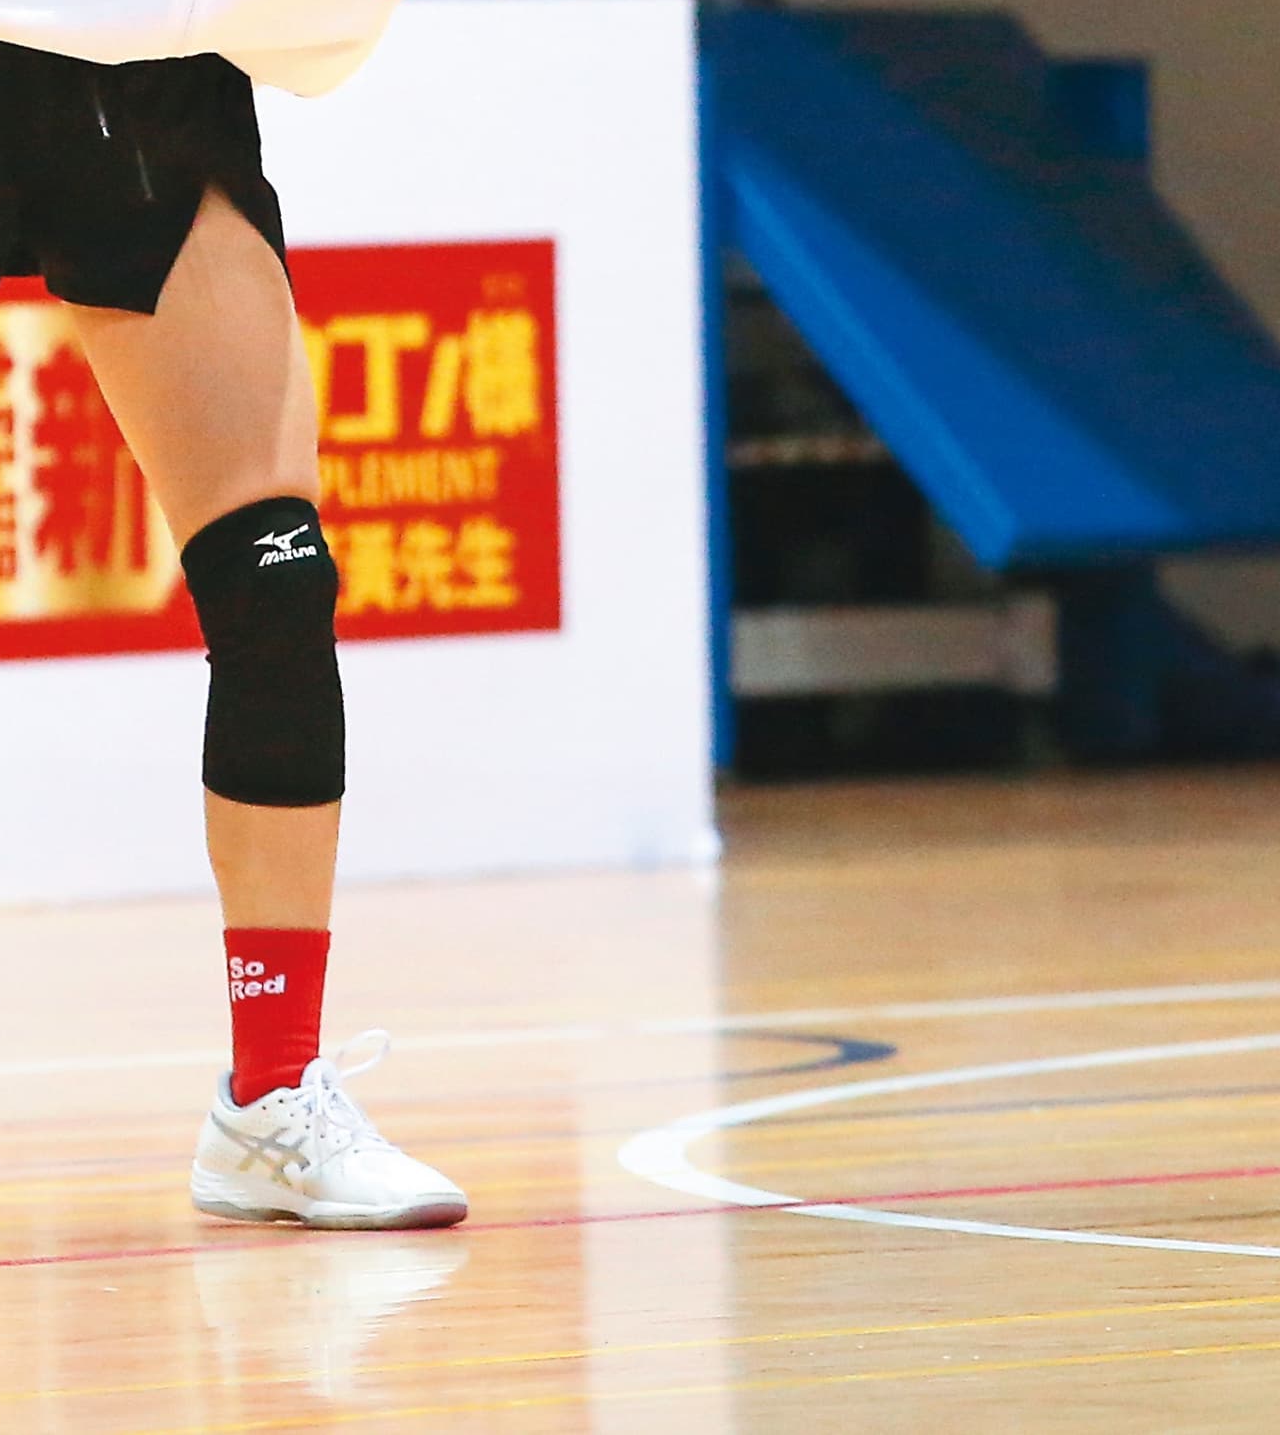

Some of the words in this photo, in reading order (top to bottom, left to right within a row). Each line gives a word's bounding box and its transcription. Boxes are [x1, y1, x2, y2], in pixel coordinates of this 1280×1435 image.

[318, 447, 499, 508] PLEMENT
[229, 956, 265, 979] So
[230, 973, 286, 1002] Red
